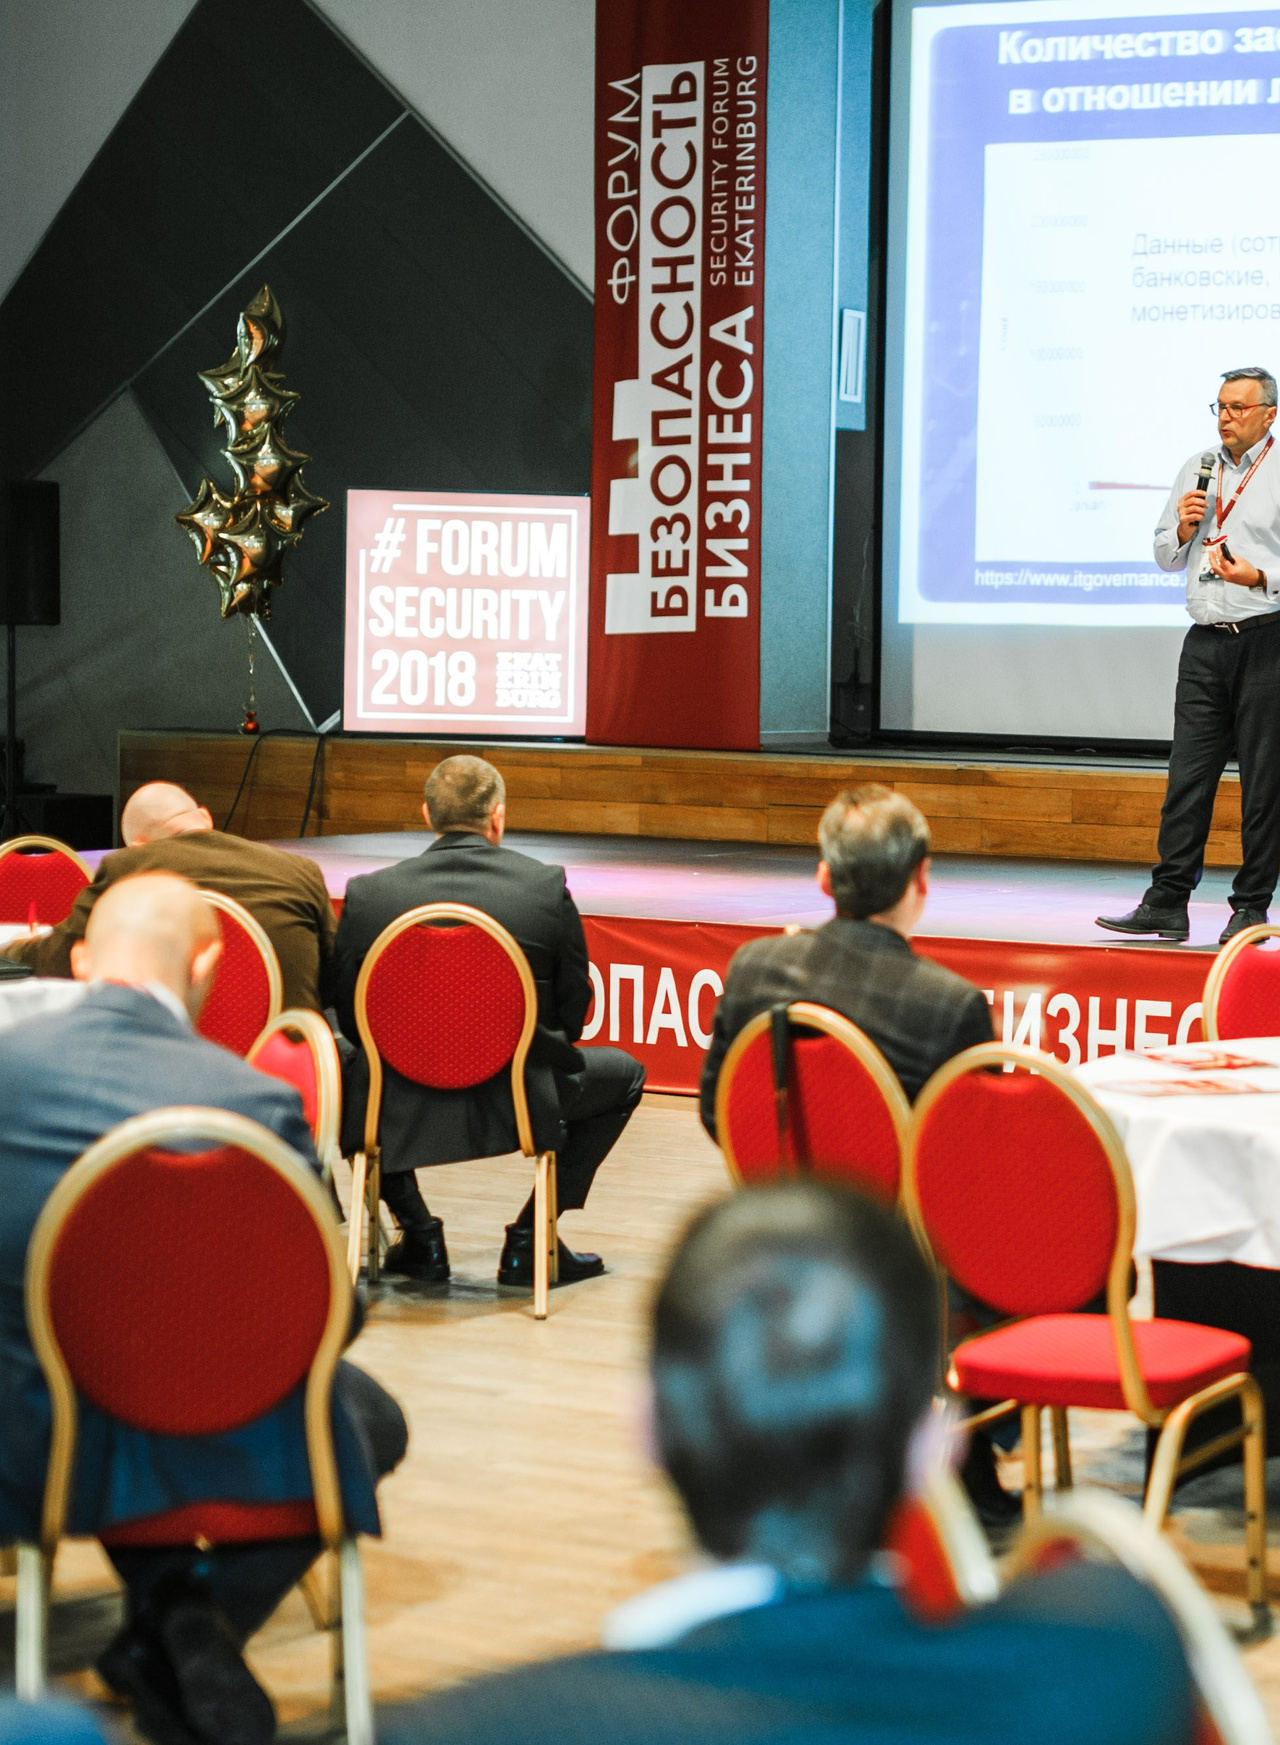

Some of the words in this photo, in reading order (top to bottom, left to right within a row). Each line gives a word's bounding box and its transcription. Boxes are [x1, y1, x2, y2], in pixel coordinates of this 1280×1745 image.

[998, 29, 1224, 65] Количество
[711, 57, 730, 150] FORUM
[1008, 89, 1031, 115] в
[1041, 78, 1258, 113] отношении
[607, 72, 641, 305] ФОРУМ
[734, 55, 758, 287] EKATERINBURG
[710, 159, 729, 287] SECURITY
[1131, 233, 1224, 258] Данные
[650, 70, 698, 618] БЕЗОПАСНОСТЬ
[704, 304, 755, 618] БИЗНЕСА
[415, 519, 568, 578] FORUM
[367, 585, 567, 642] SECURITY
[370, 648, 477, 708] 2018
